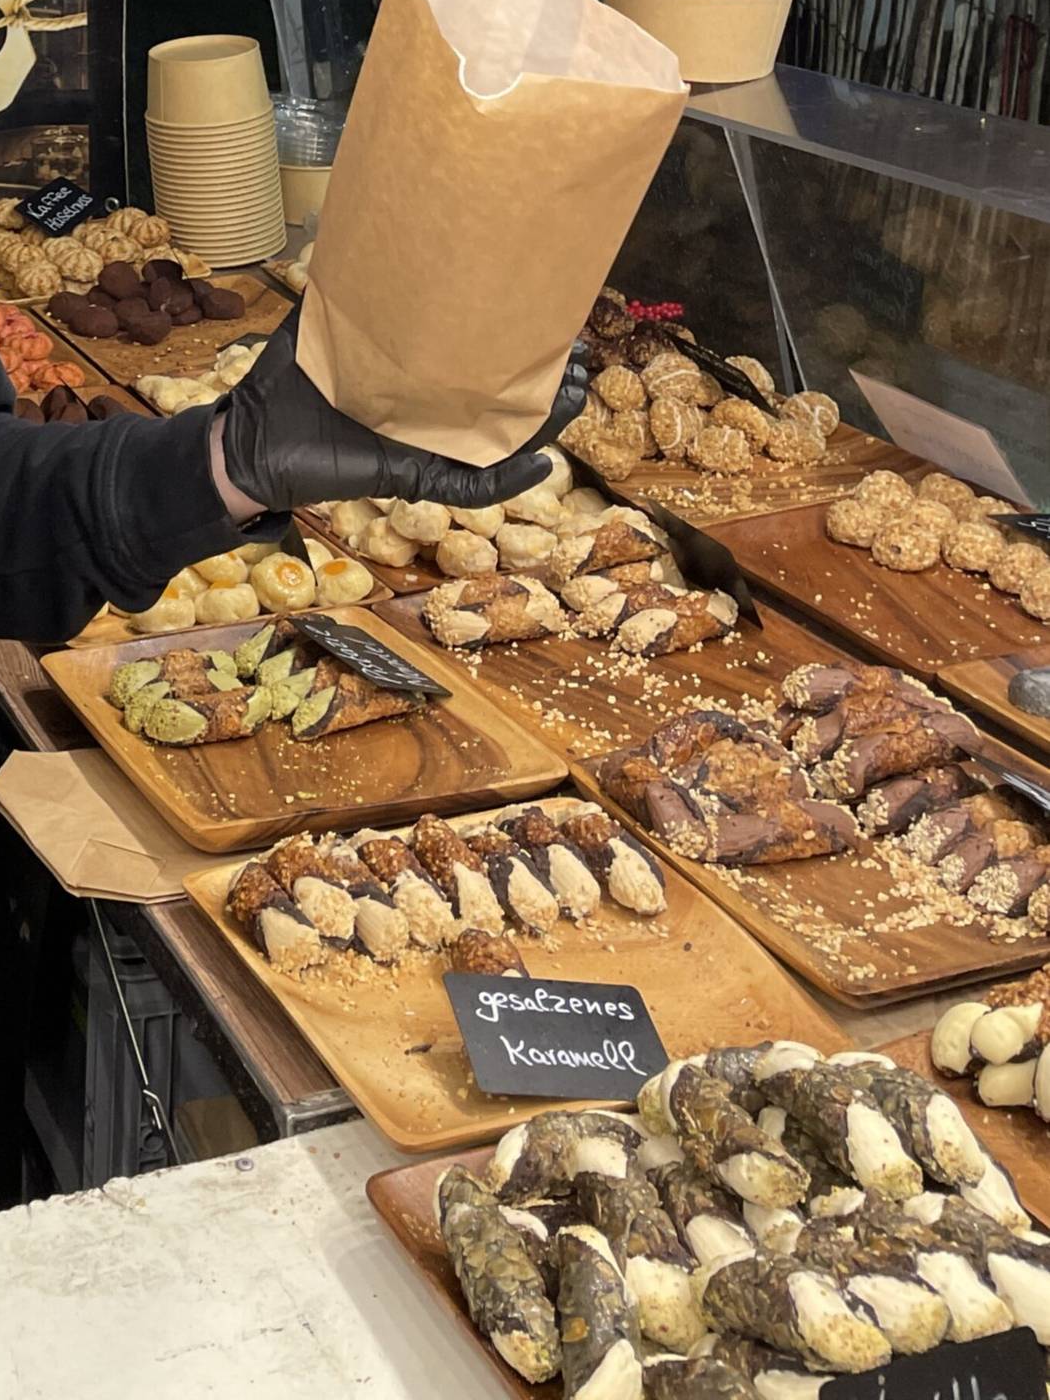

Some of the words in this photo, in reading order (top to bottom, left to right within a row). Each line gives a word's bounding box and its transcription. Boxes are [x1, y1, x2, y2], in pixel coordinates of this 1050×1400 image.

[27, 186, 73, 220] Kaffee
[475, 987, 636, 1023] gesalzenes
[499, 1034, 649, 1077] Karamell
